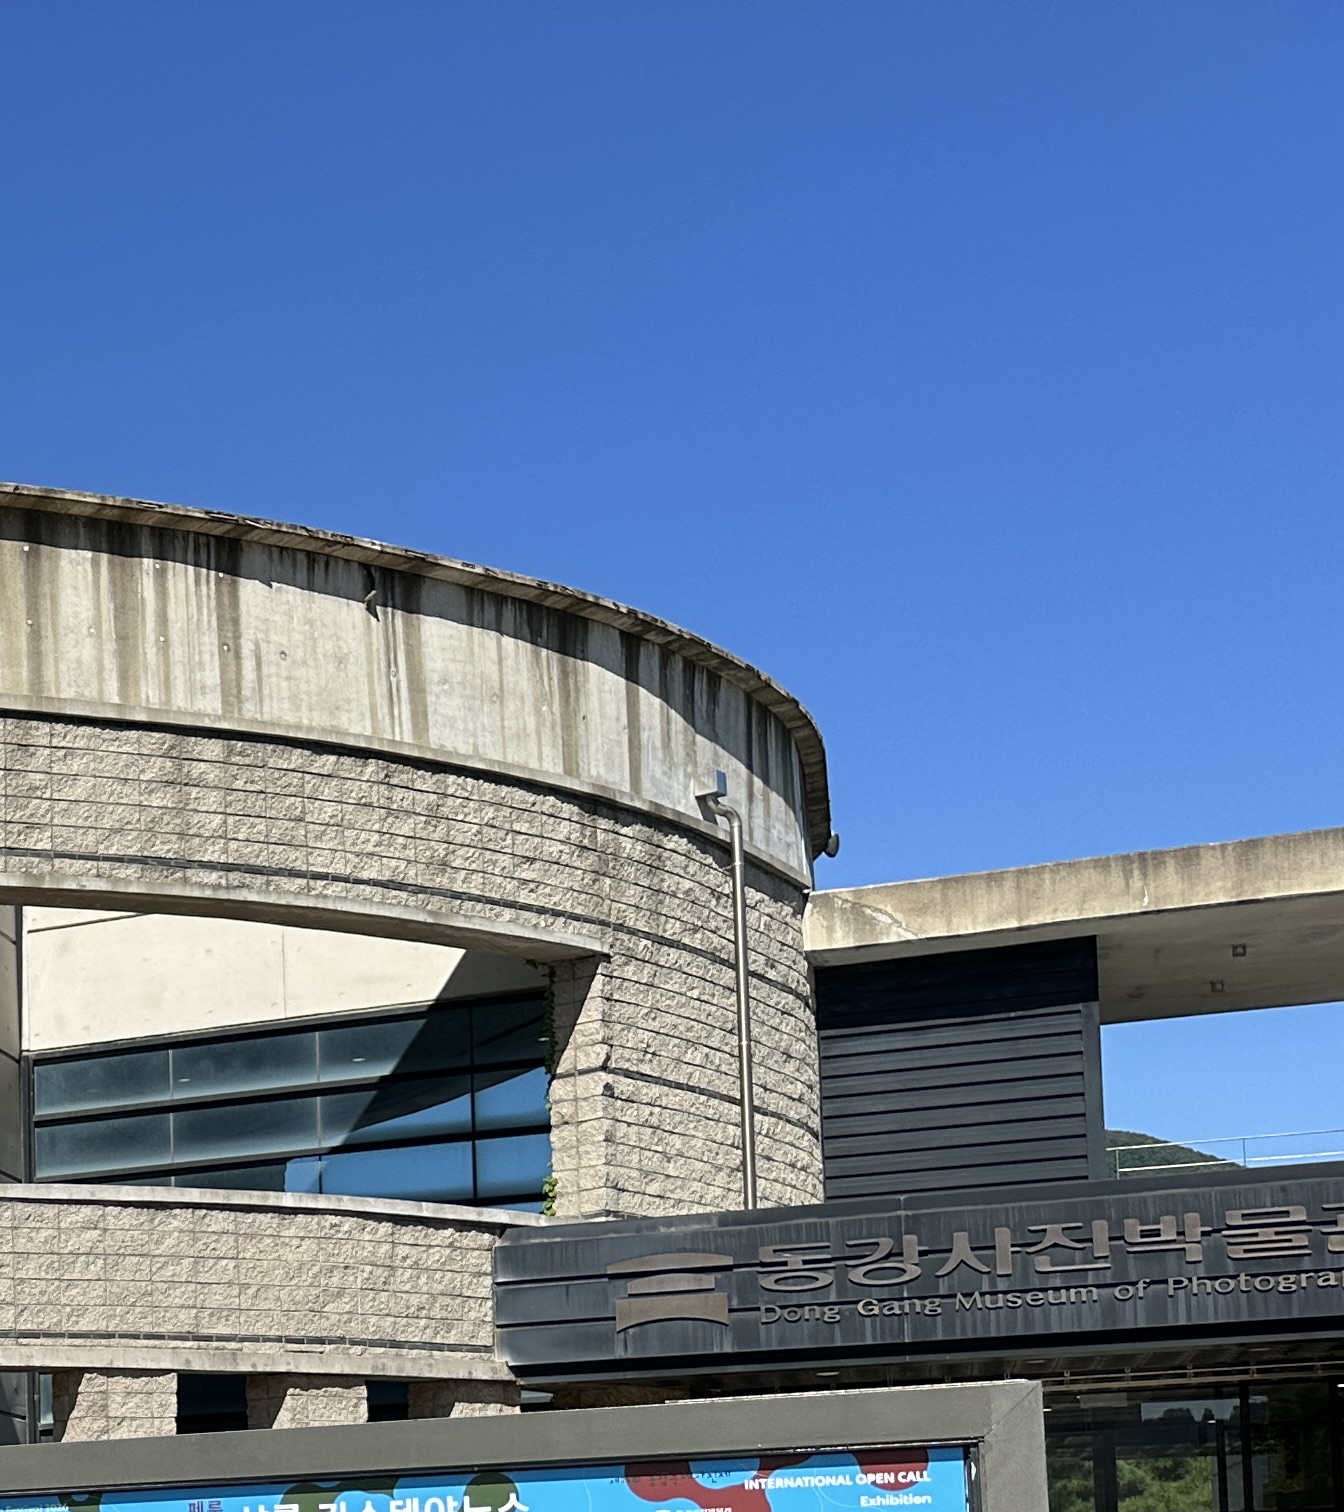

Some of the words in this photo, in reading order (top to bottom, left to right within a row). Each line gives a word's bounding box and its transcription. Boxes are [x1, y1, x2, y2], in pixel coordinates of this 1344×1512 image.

[757, 1203, 1344, 1292] 동강사진박물
[760, 1304, 842, 1325] Dong
[857, 1298, 944, 1317] Gang
[955, 1285, 1099, 1311] Museum
[1114, 1278, 1151, 1301] of
[1167, 1270, 1344, 1297] Photogra
[744, 1474, 853, 1491] INTERNATIONAL
[855, 1472, 895, 1486] OPEN
[897, 1470, 932, 1483] CALL
[859, 1494, 932, 1507] Exhibition
